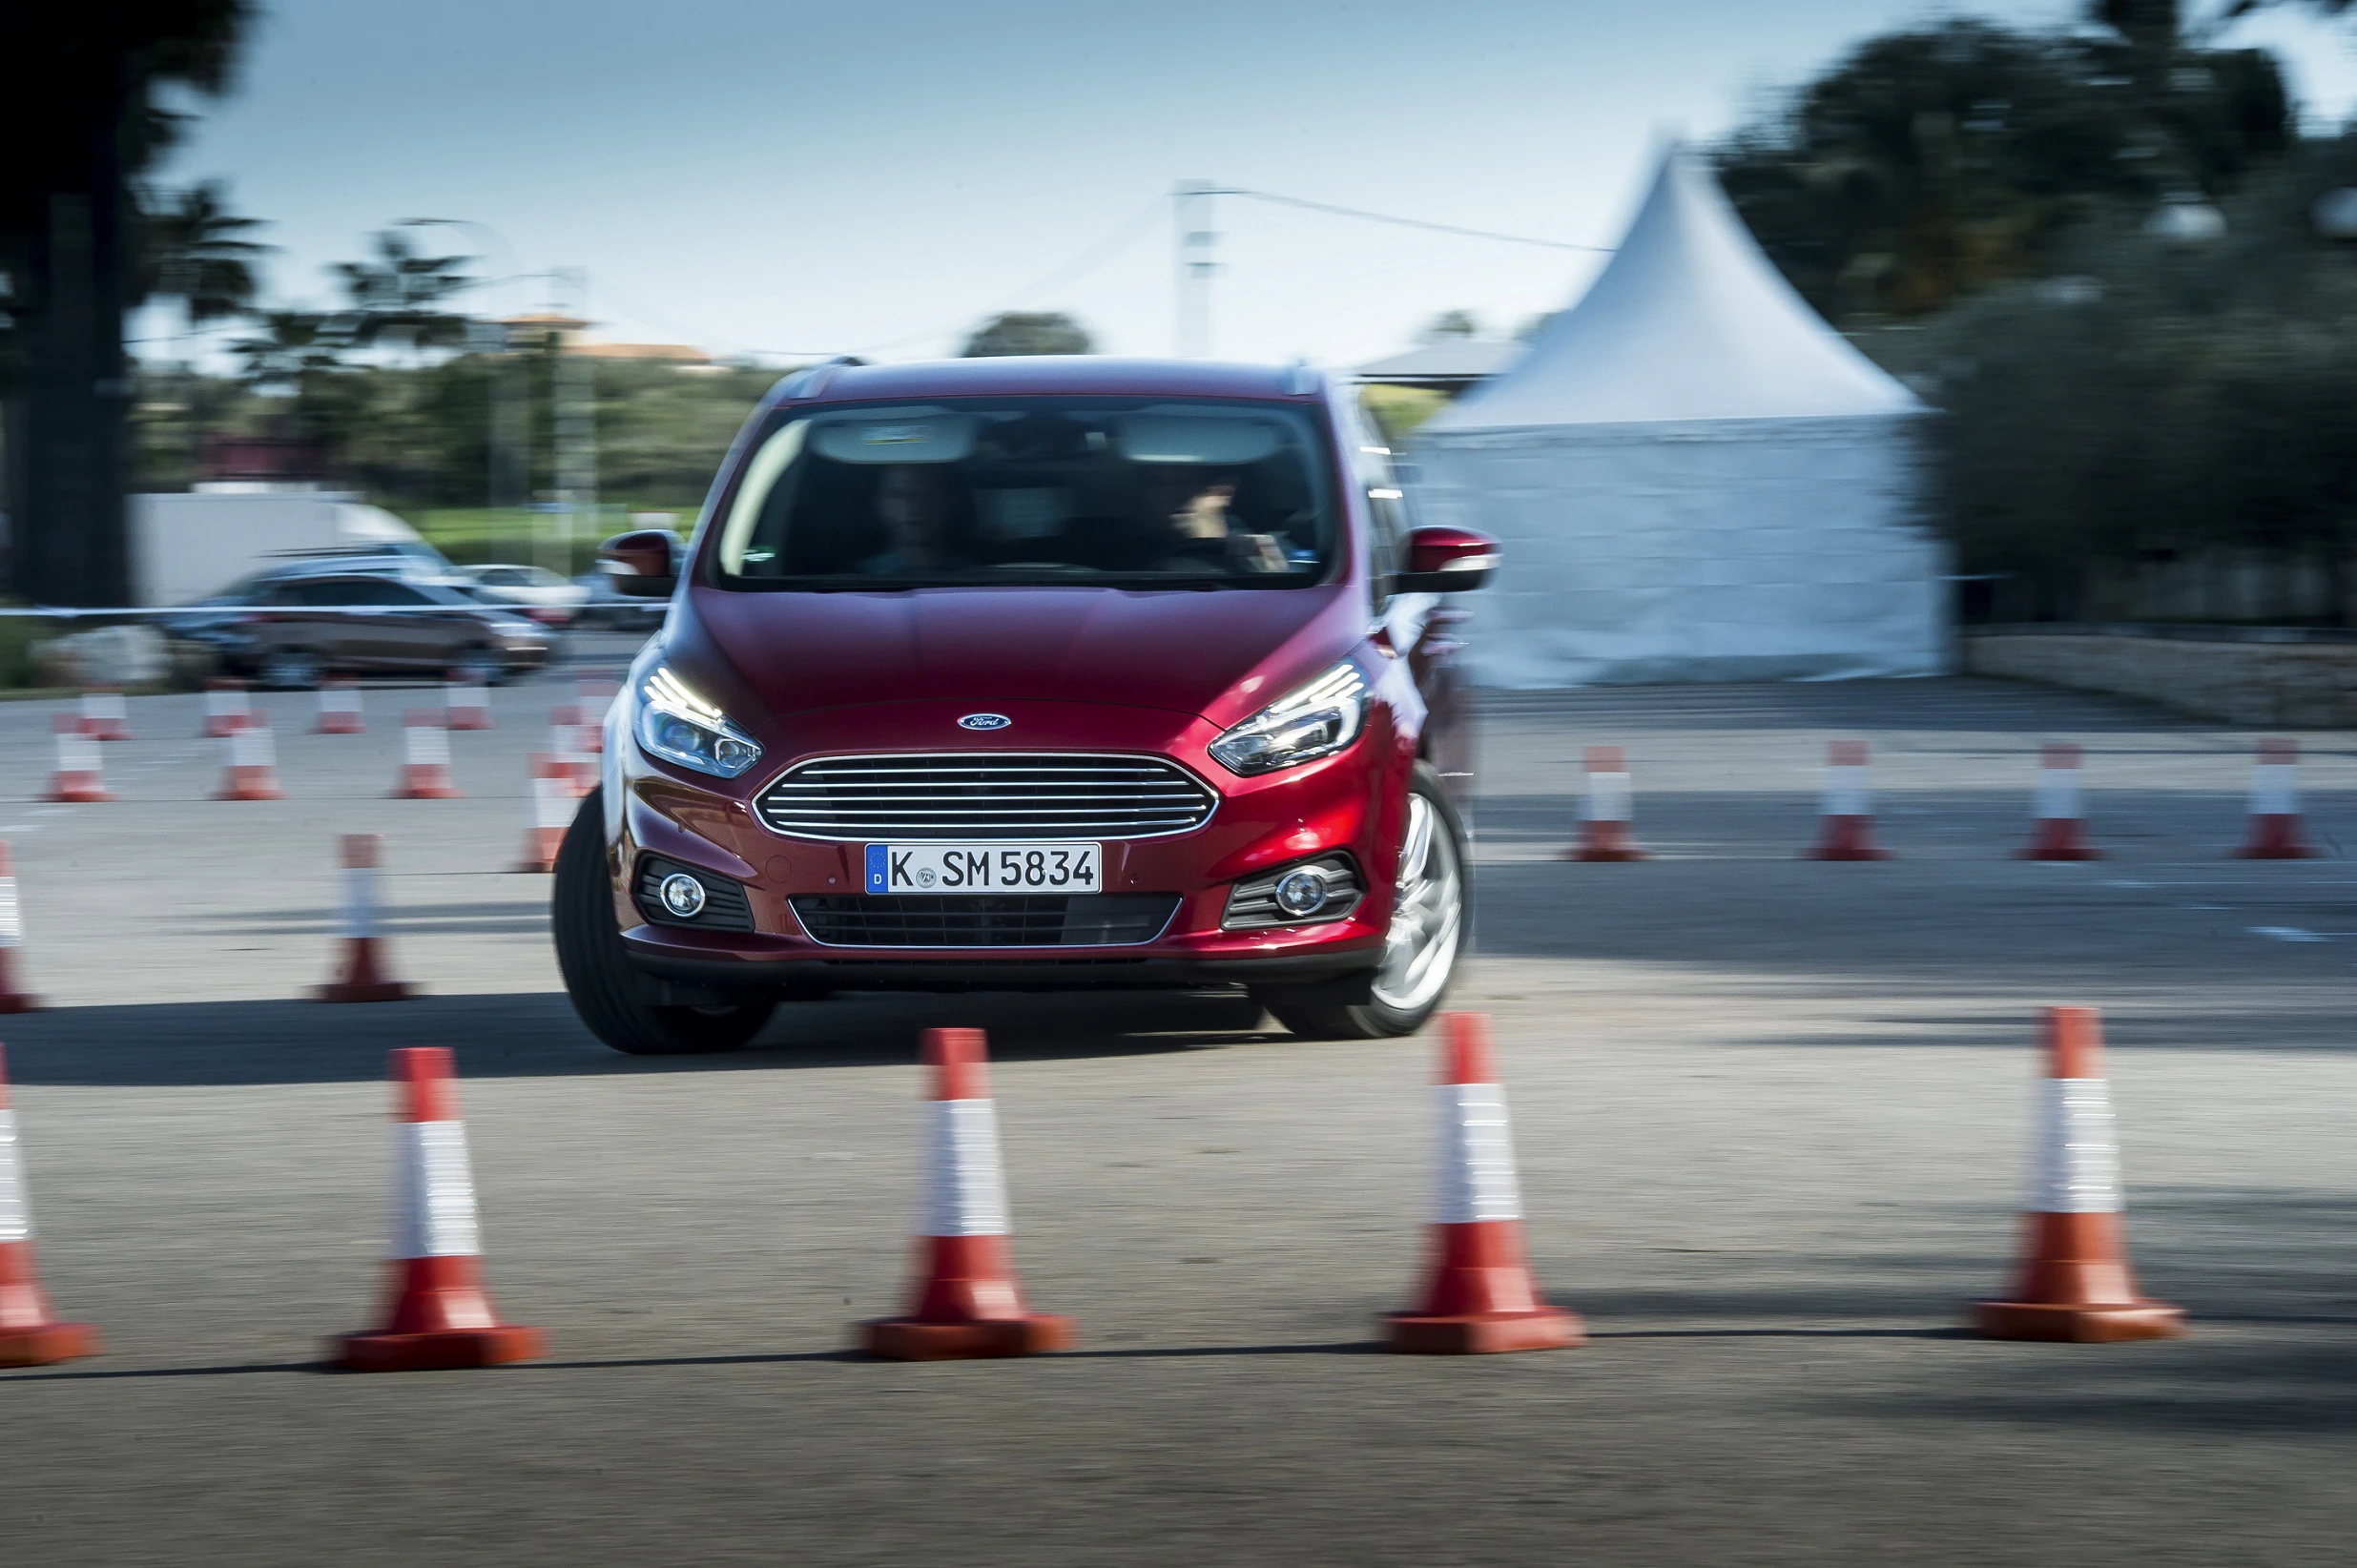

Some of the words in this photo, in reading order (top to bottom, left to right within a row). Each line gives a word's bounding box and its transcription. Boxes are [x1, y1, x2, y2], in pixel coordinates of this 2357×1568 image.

[970, 716, 1000, 726] Ford
[891, 851, 914, 887] K
[941, 851, 990, 887] SM
[1001, 851, 1094, 886] 5834
[874, 874, 882, 885] D
